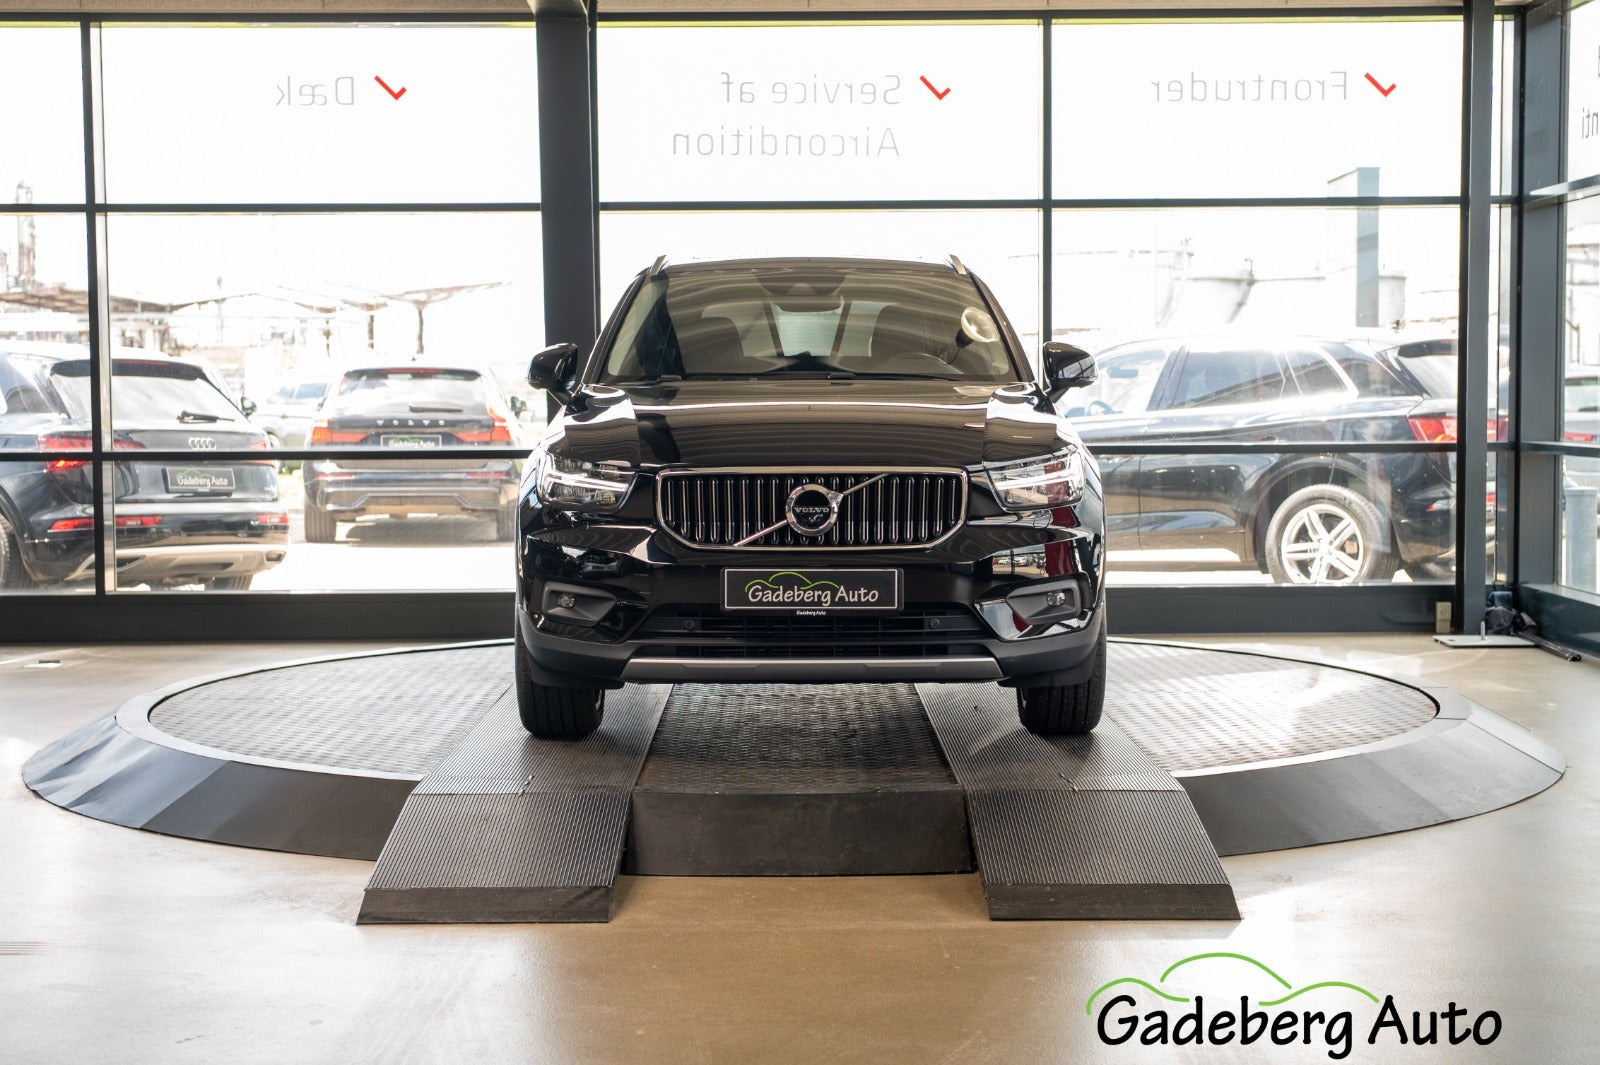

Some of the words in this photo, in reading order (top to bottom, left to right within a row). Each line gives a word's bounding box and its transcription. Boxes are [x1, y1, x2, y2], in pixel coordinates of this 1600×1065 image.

[376, 418, 445, 427] VOLVO
[211, 475, 229, 486] Auto
[748, 585, 831, 607] Gadeberg
[835, 585, 878, 603] Auto
